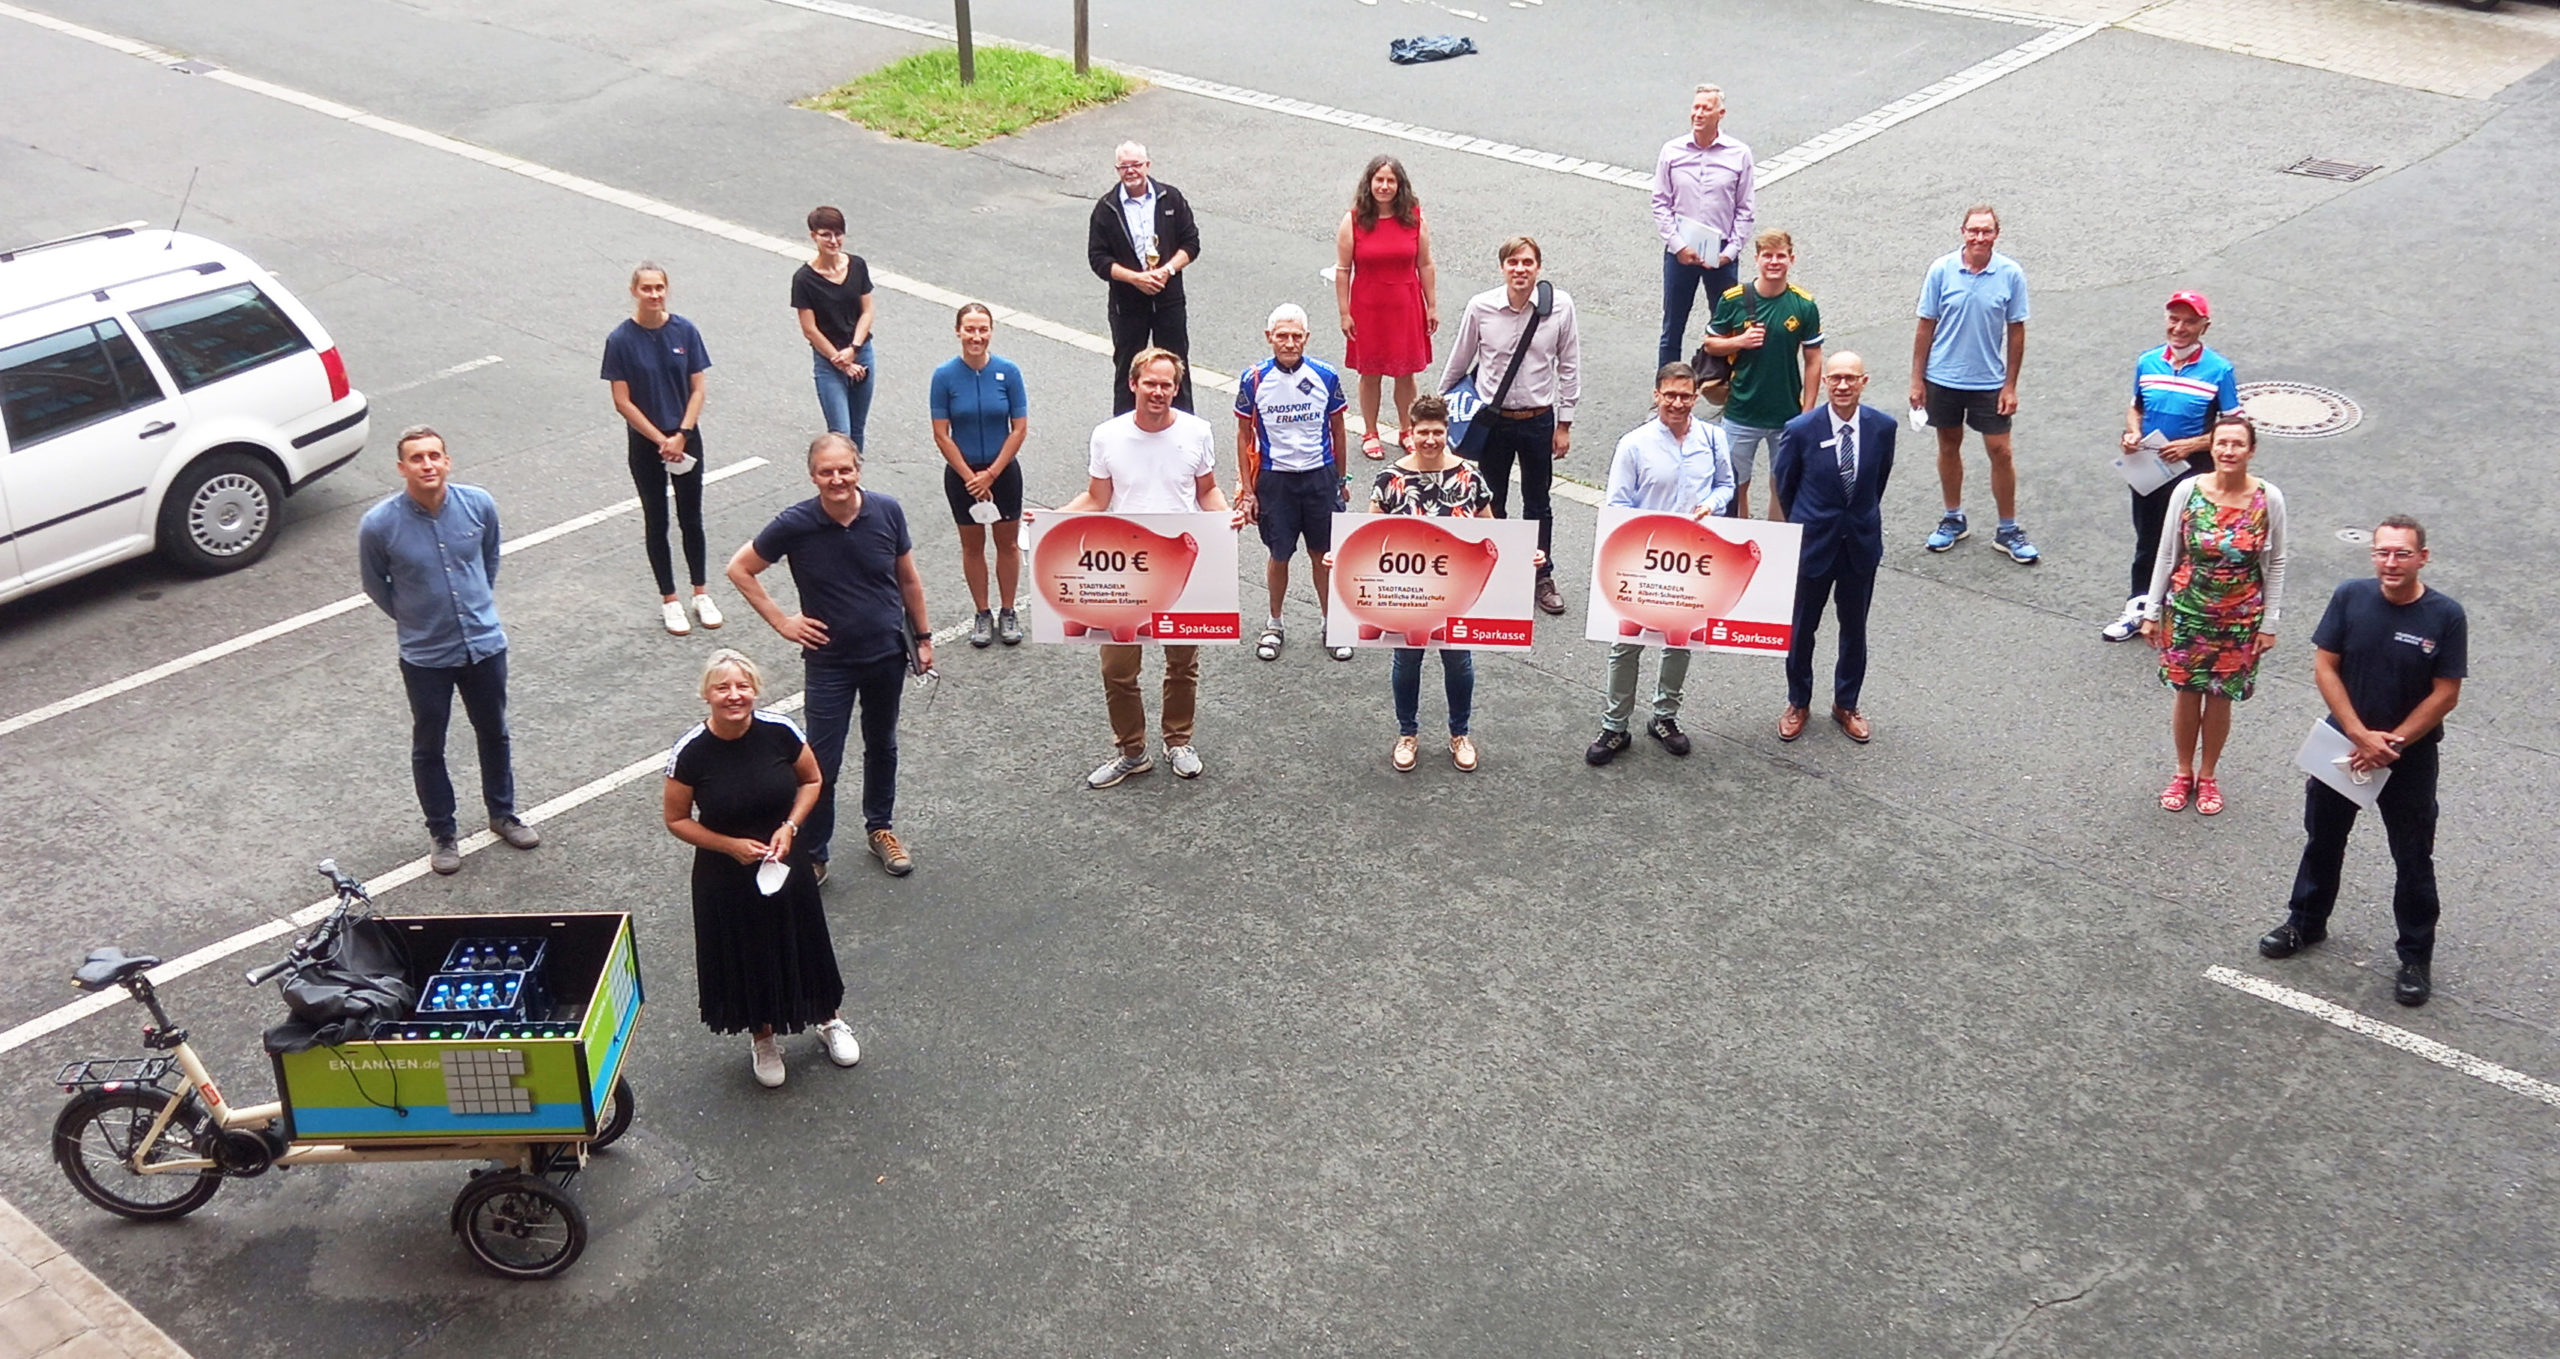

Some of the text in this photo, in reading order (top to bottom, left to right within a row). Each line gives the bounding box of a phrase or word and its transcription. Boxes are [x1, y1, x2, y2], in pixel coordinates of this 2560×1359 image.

[1267, 403, 1312, 414] RADSPORT
[1276, 412, 1320, 424] ERLANGEN
[1078, 551, 1149, 572] 400 €
[1379, 552, 1449, 576] 600 €
[1644, 549, 1713, 576] 500 €
[1618, 580, 1632, 594] 2.
[1178, 624, 1234, 635] Sparkasse
[1472, 629, 1526, 641] Sparkasse
[1731, 631, 1785, 646] Sparkasse
